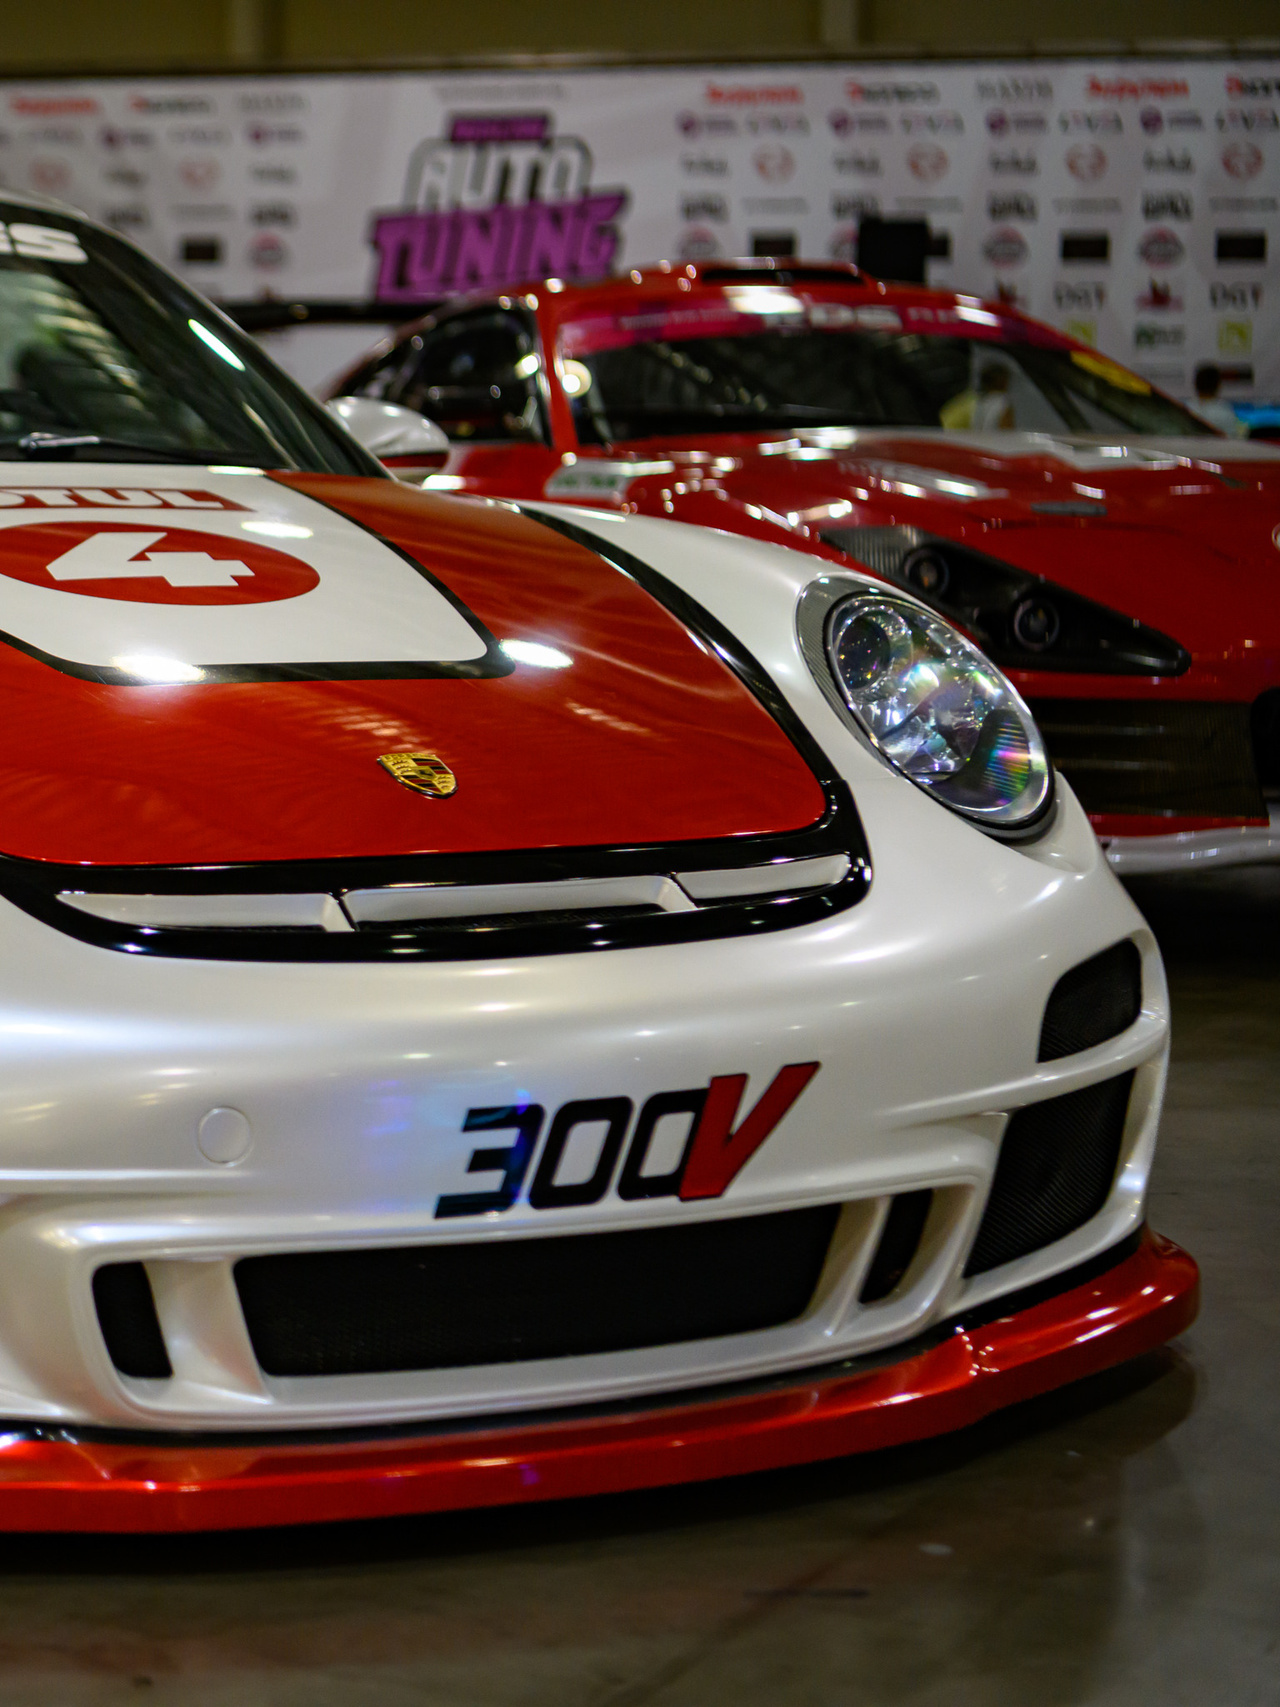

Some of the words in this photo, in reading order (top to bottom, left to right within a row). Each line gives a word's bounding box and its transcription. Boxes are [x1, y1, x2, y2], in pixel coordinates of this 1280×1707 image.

[408, 138, 589, 212] AUTO
[374, 192, 626, 302] TUNING
[45, 531, 255, 588] 4
[434, 1061, 821, 1219] 300V
